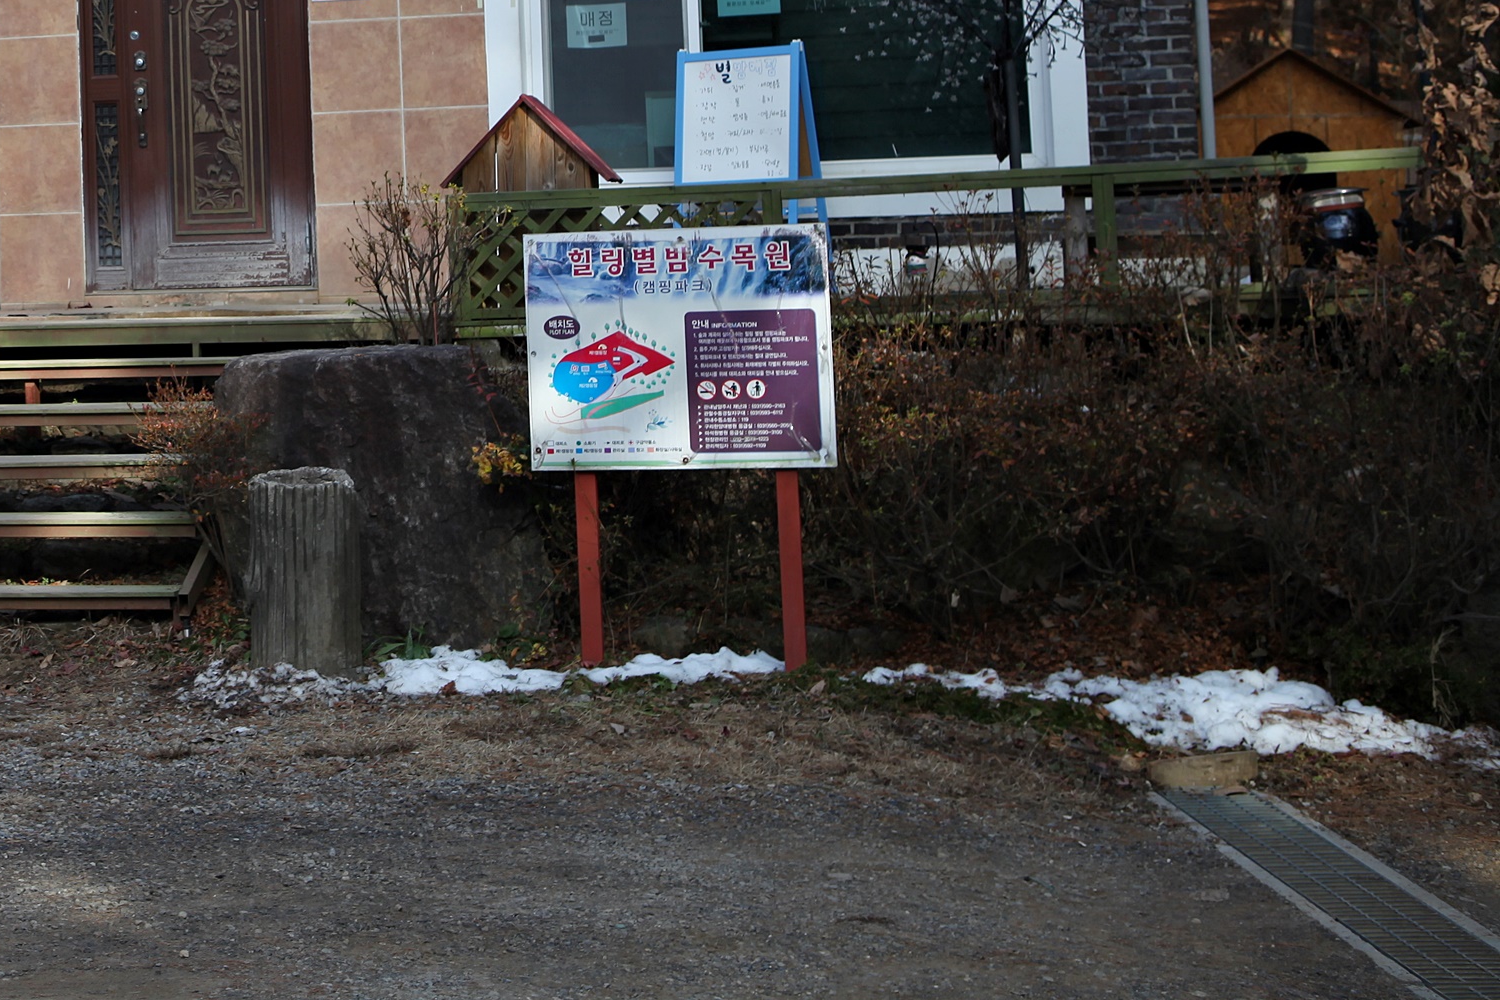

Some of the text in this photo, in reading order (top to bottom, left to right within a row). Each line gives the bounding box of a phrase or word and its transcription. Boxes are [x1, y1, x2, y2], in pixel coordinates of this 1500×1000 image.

[580, 10, 613, 27] 매점
[567, 240, 792, 277] 힐링별밤수목원
[634, 279, 713, 295] (캠핑파크)
[549, 320, 575, 328] 배치도
[692, 320, 709, 329] 안내
